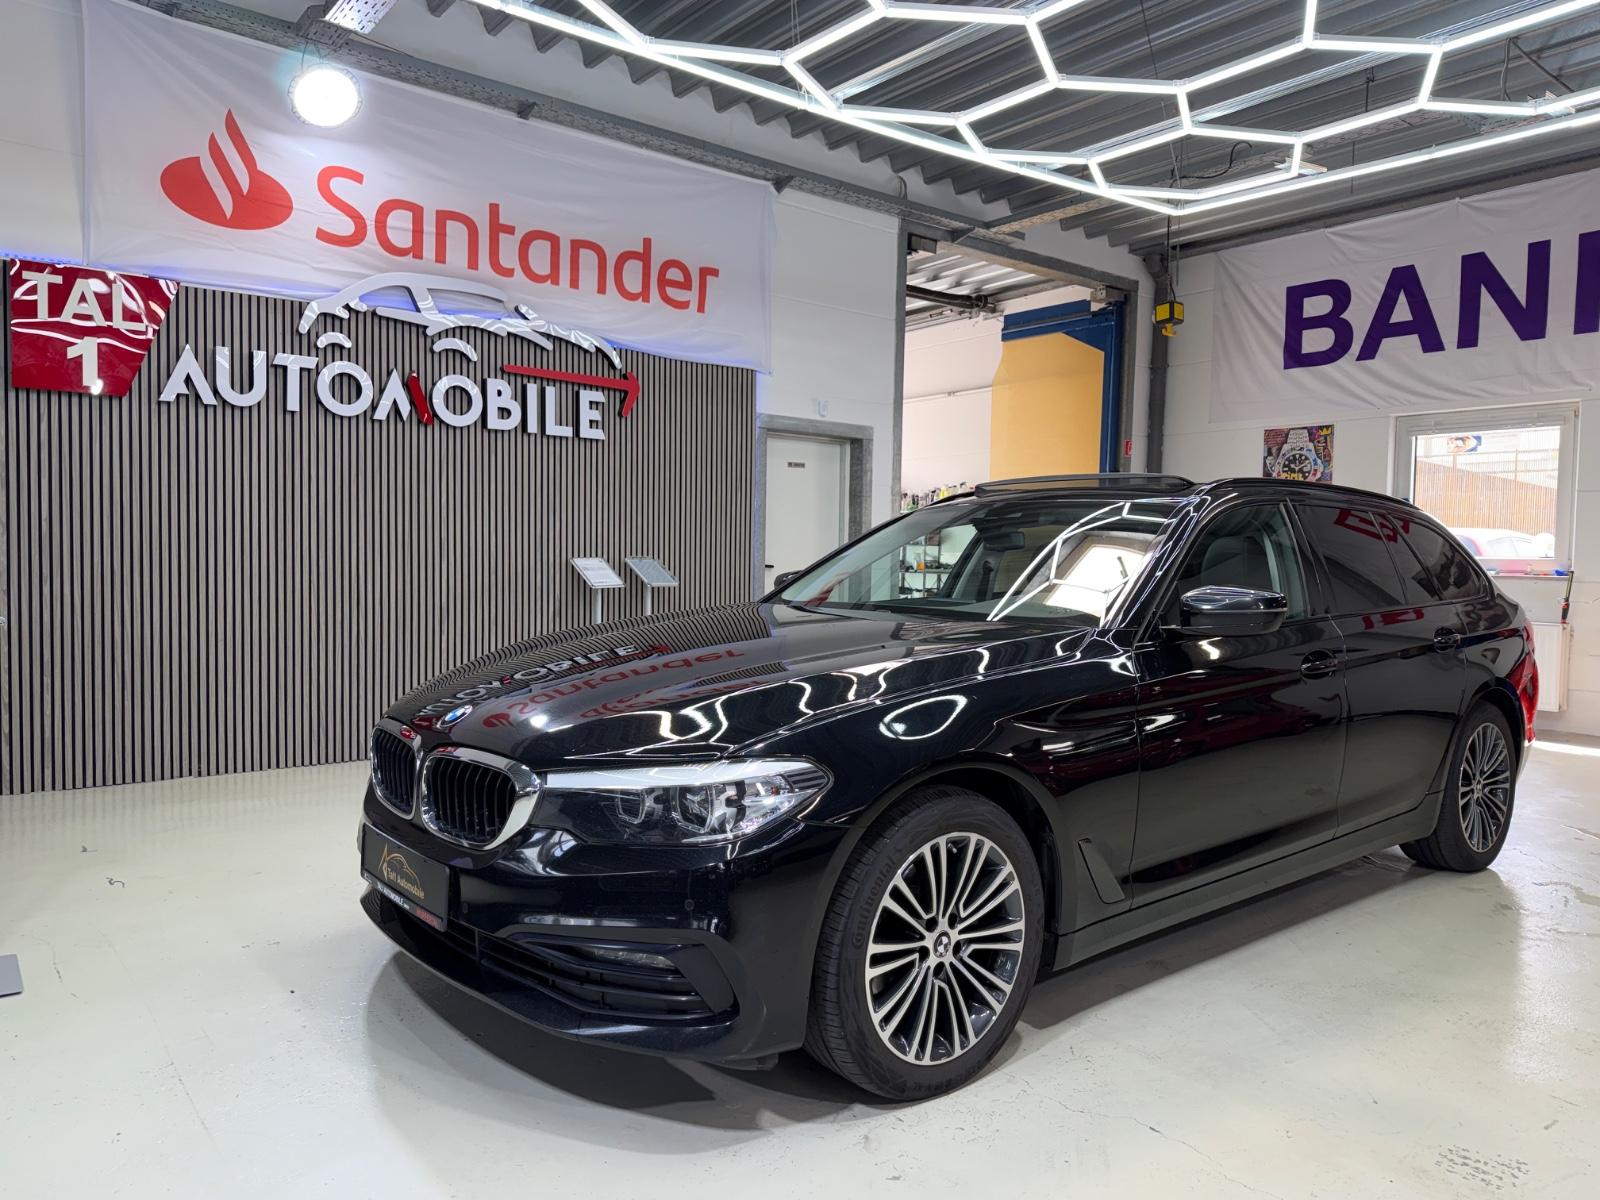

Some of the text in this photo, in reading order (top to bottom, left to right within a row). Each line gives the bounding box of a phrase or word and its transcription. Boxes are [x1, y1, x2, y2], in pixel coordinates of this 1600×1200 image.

[315, 165, 720, 314] Santander
[22, 270, 147, 332] TAL
[1283, 230, 1600, 370] BAN
[66, 336, 98, 387] 1
[158, 344, 606, 440] AUTOMOBILE
